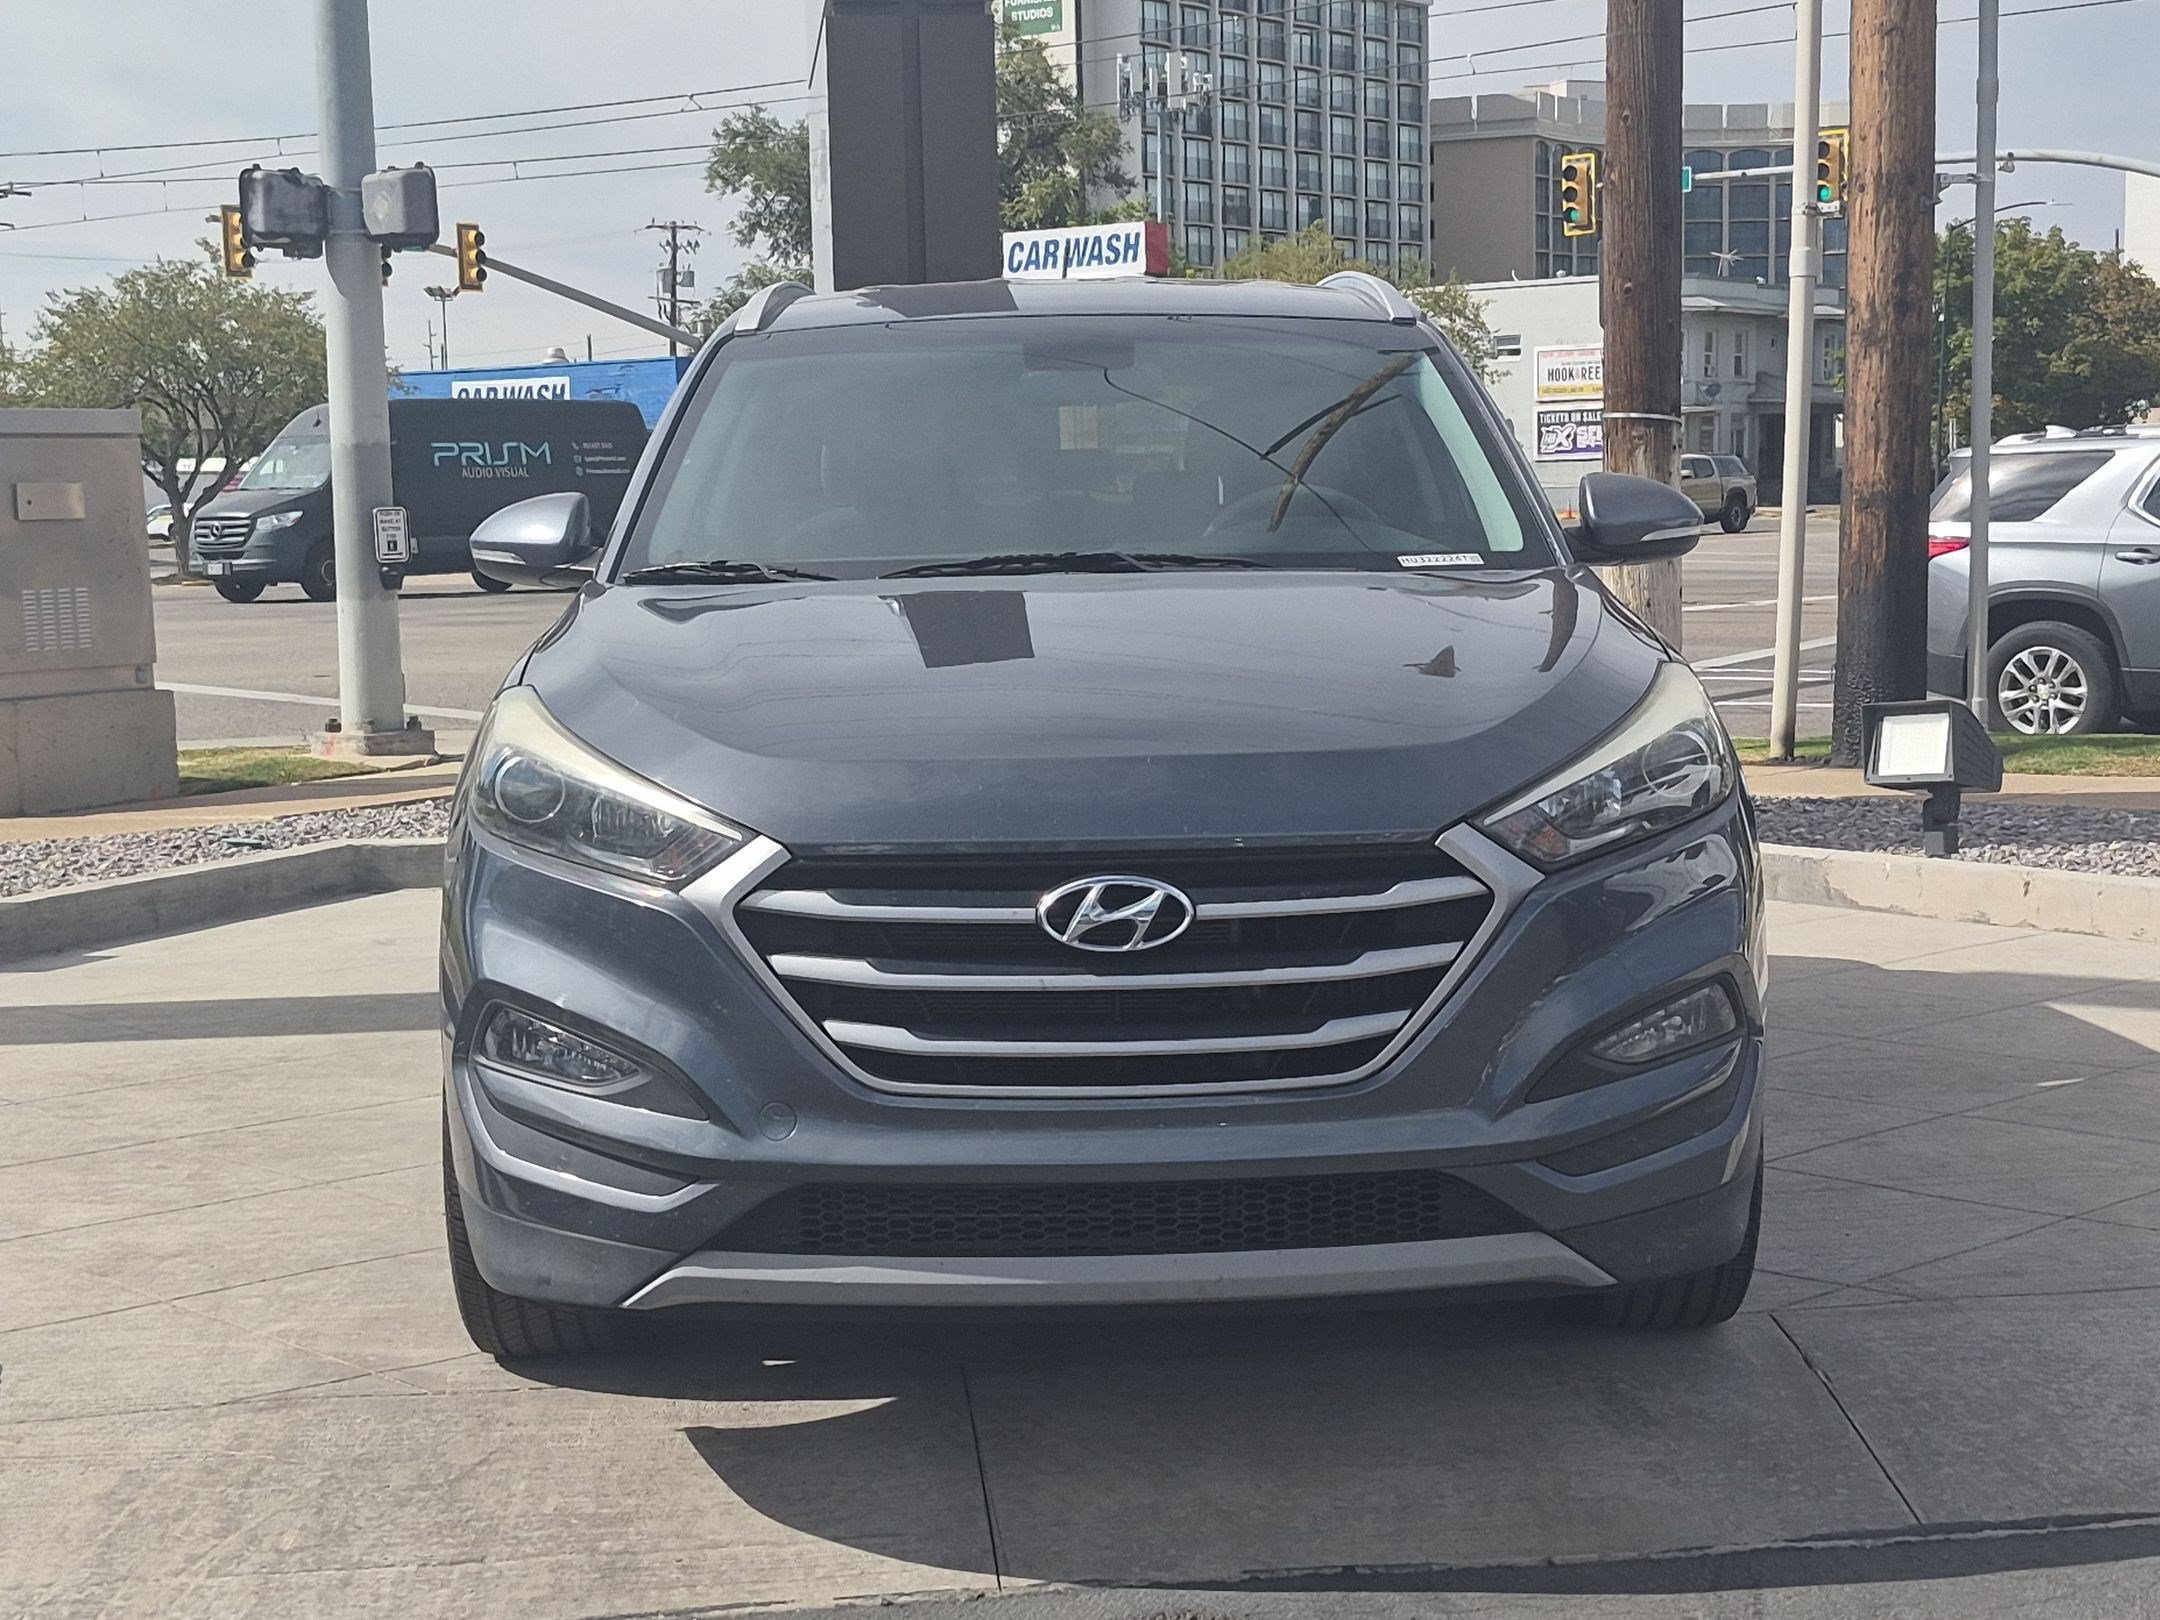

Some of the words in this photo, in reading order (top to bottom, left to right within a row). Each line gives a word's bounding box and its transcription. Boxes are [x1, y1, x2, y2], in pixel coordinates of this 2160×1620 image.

[1011, 6, 1054, 22] STUDIOS
[1008, 239, 1060, 273] CAR
[1065, 232, 1141, 268] WASH
[1547, 367, 1575, 382] HOOK
[1582, 411, 1603, 423] SALE
[430, 441, 552, 467] PRISM
[462, 467, 493, 479] AUDIO
[494, 466, 530, 478] VISUAL
